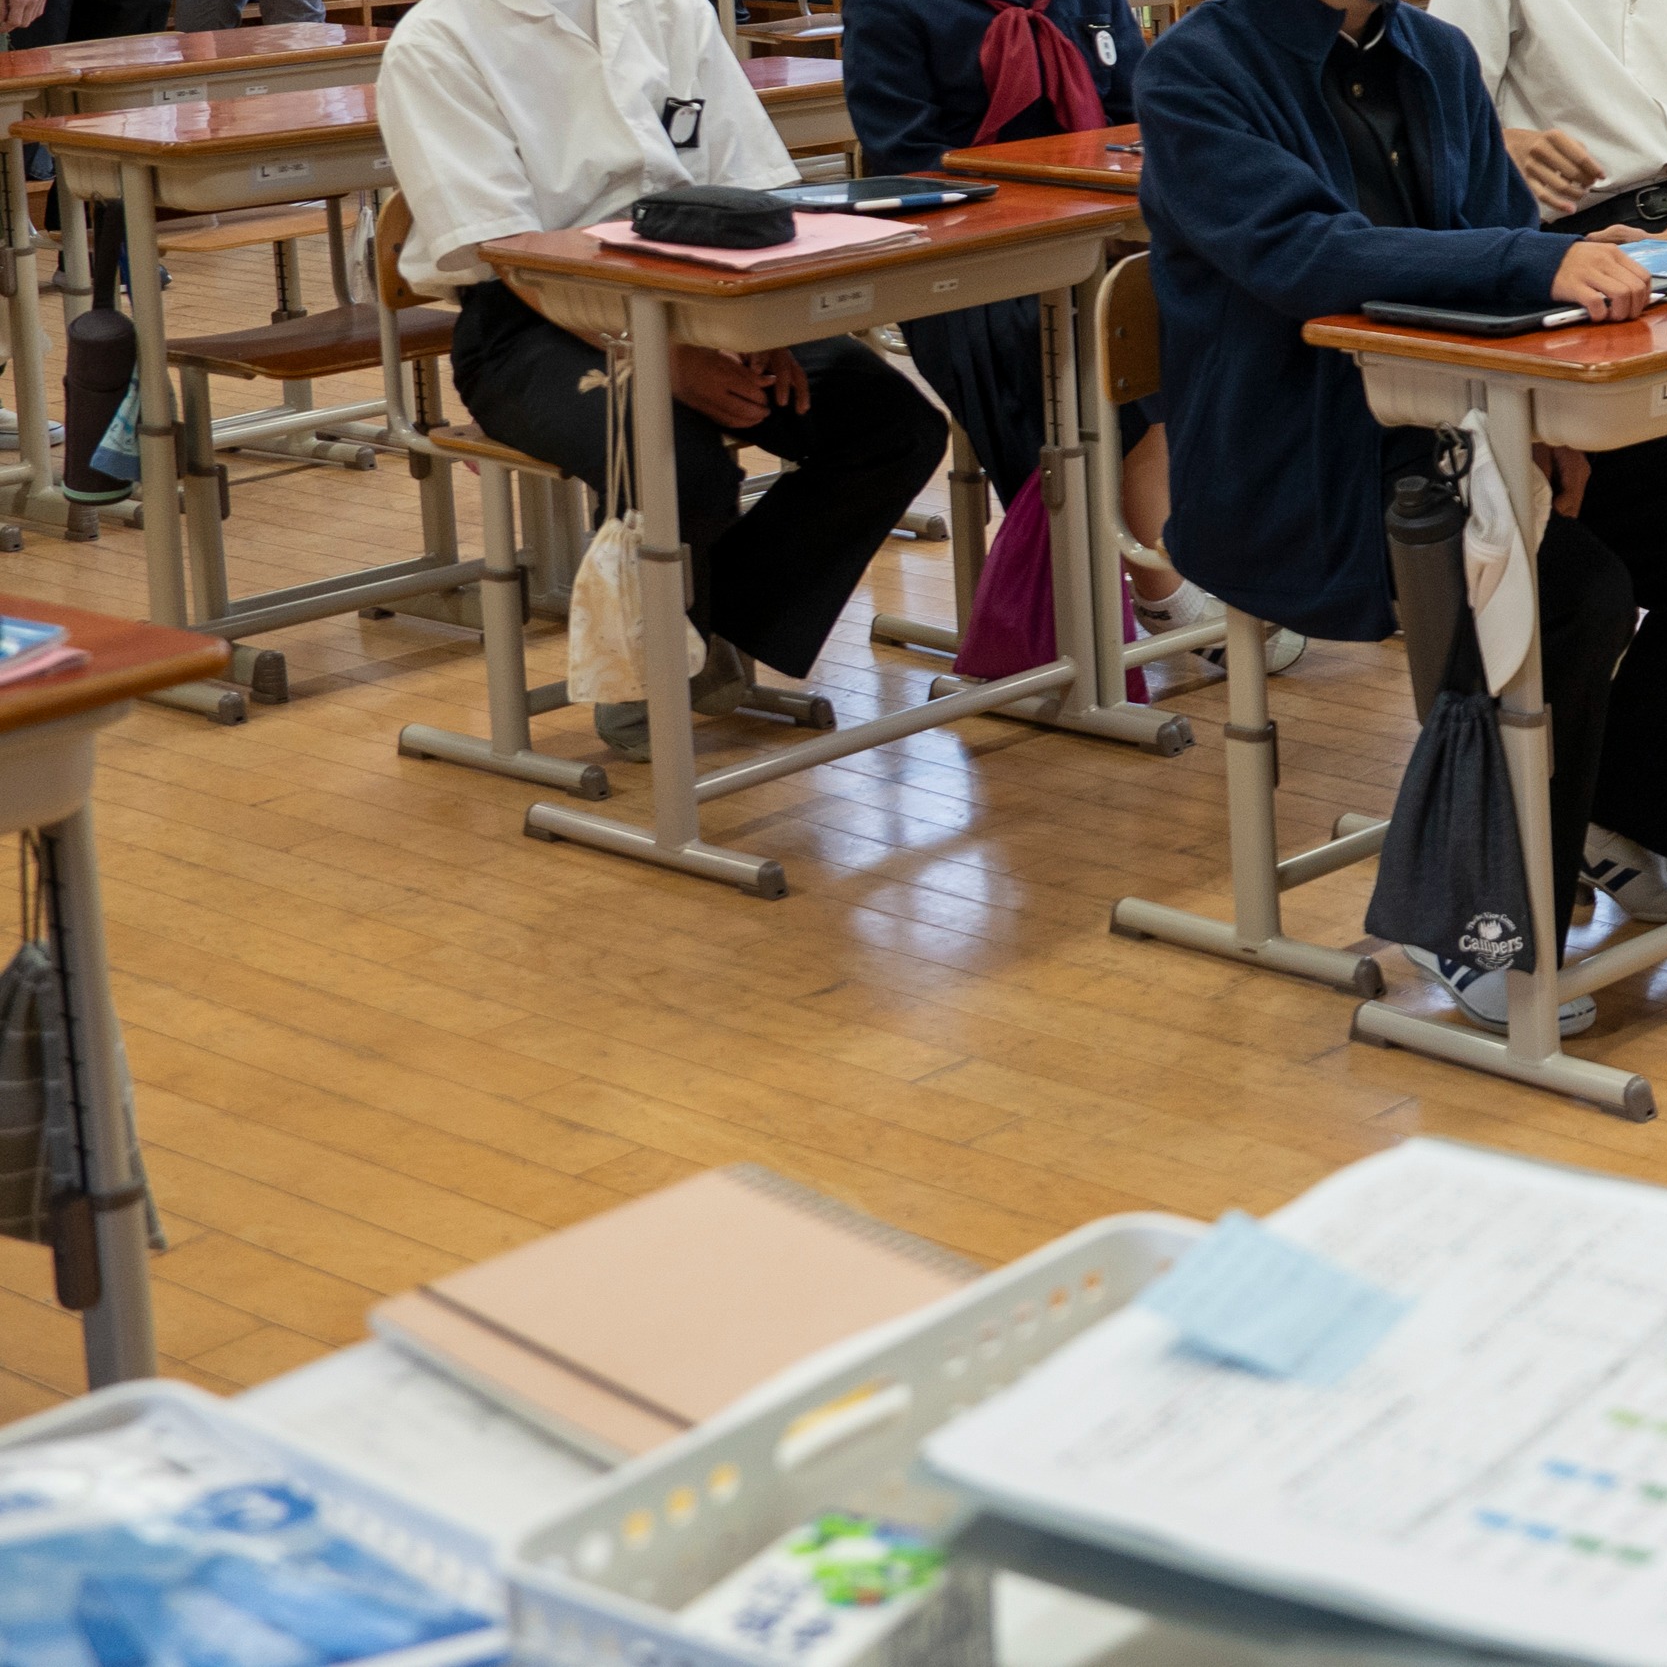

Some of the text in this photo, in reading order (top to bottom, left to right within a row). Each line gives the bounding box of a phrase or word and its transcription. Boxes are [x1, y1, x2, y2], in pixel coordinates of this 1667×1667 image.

[163, 90, 170, 101] L
[261, 166, 270, 178] L
[820, 296, 829, 308] L
[1458, 934, 1524, 958] Campers
